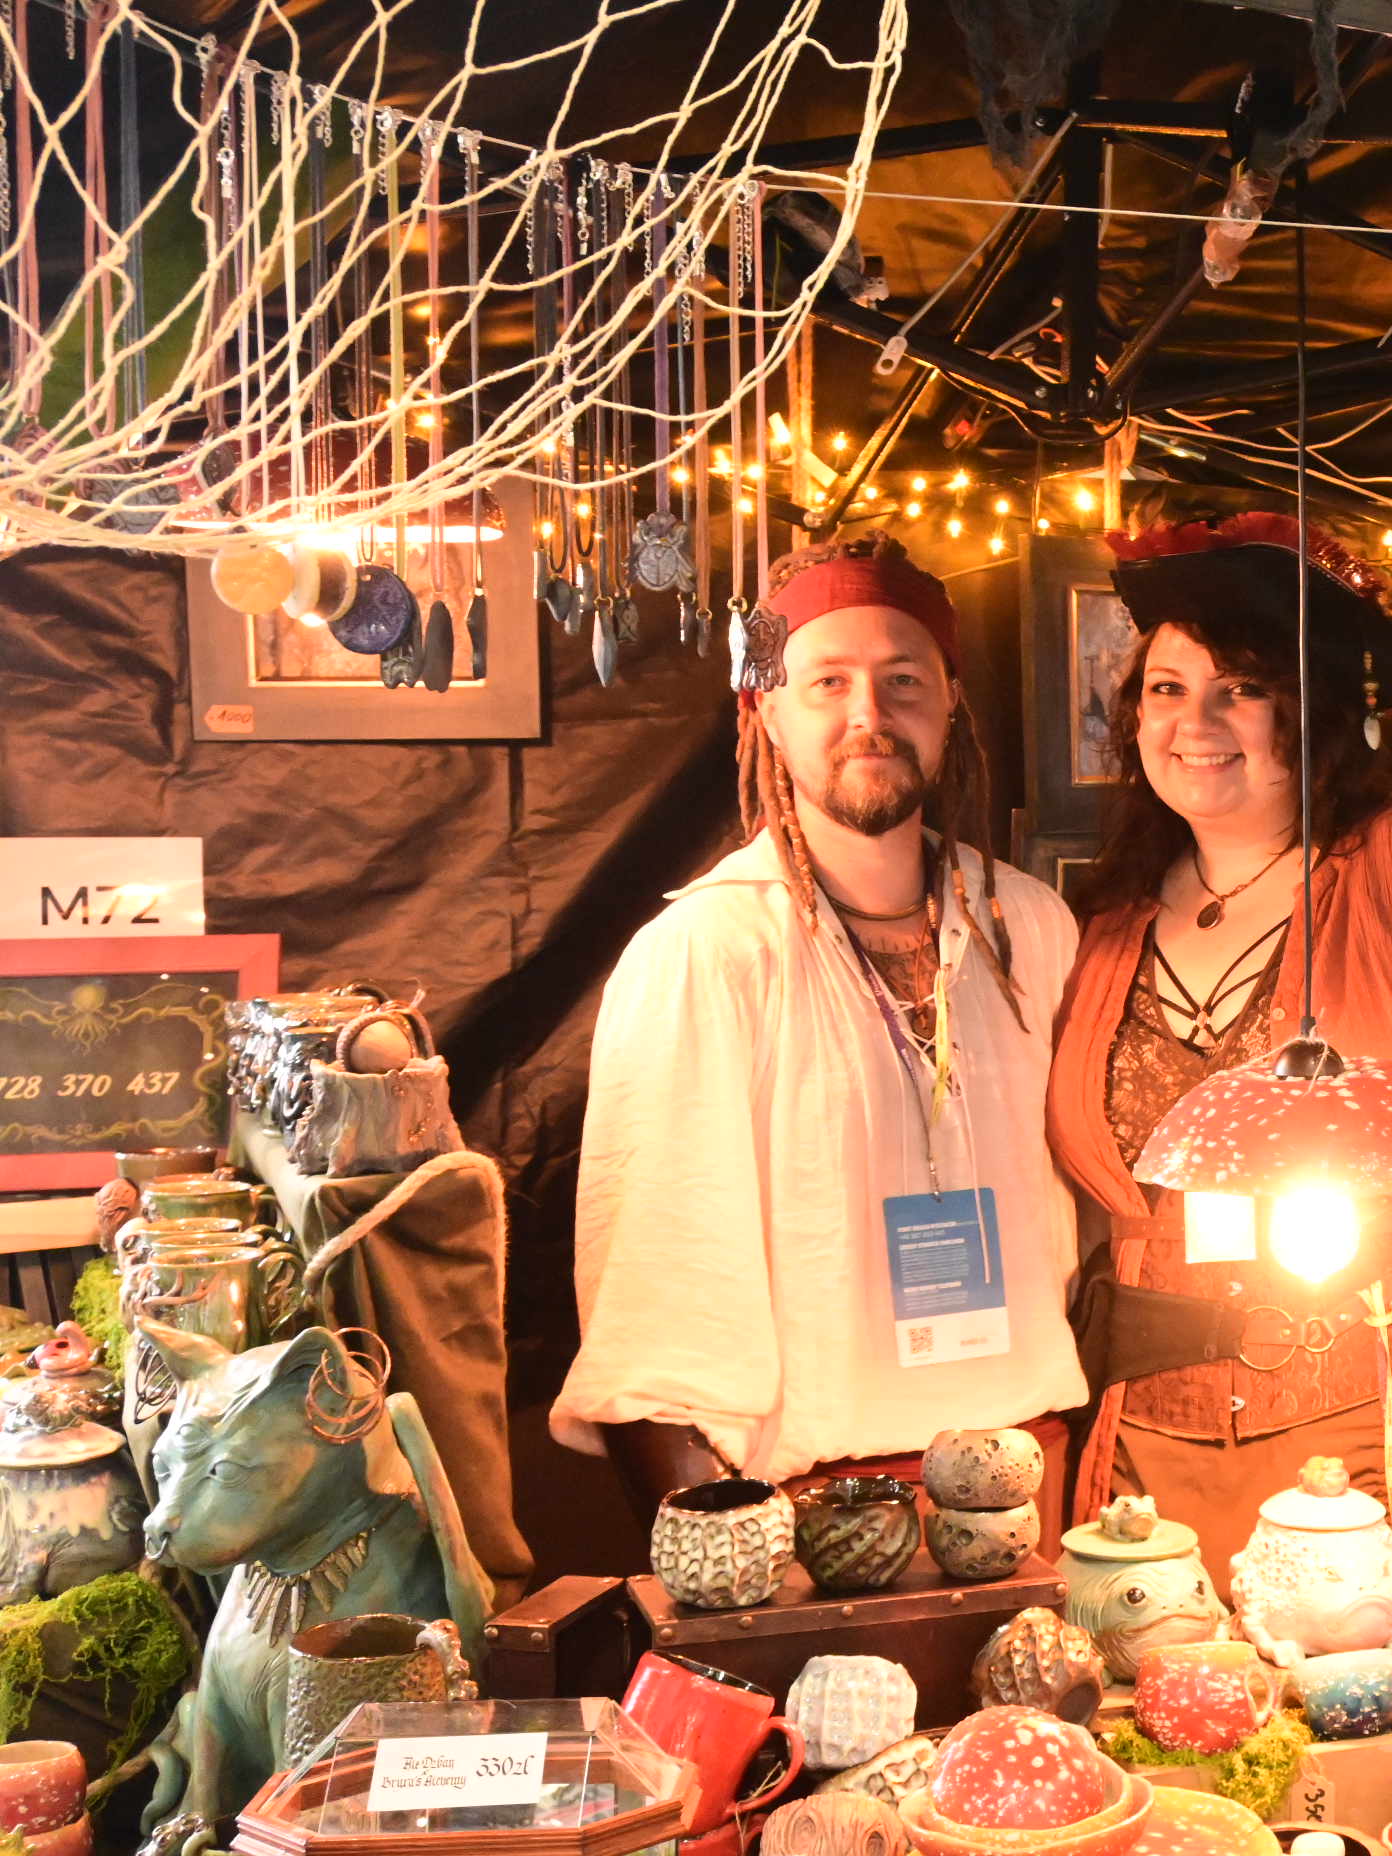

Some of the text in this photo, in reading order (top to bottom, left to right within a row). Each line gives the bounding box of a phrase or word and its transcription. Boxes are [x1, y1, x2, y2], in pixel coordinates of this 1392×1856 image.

[40, 885, 161, 926] M72
[57, 1073, 112, 1098] 370
[126, 1070, 181, 1096] 437
